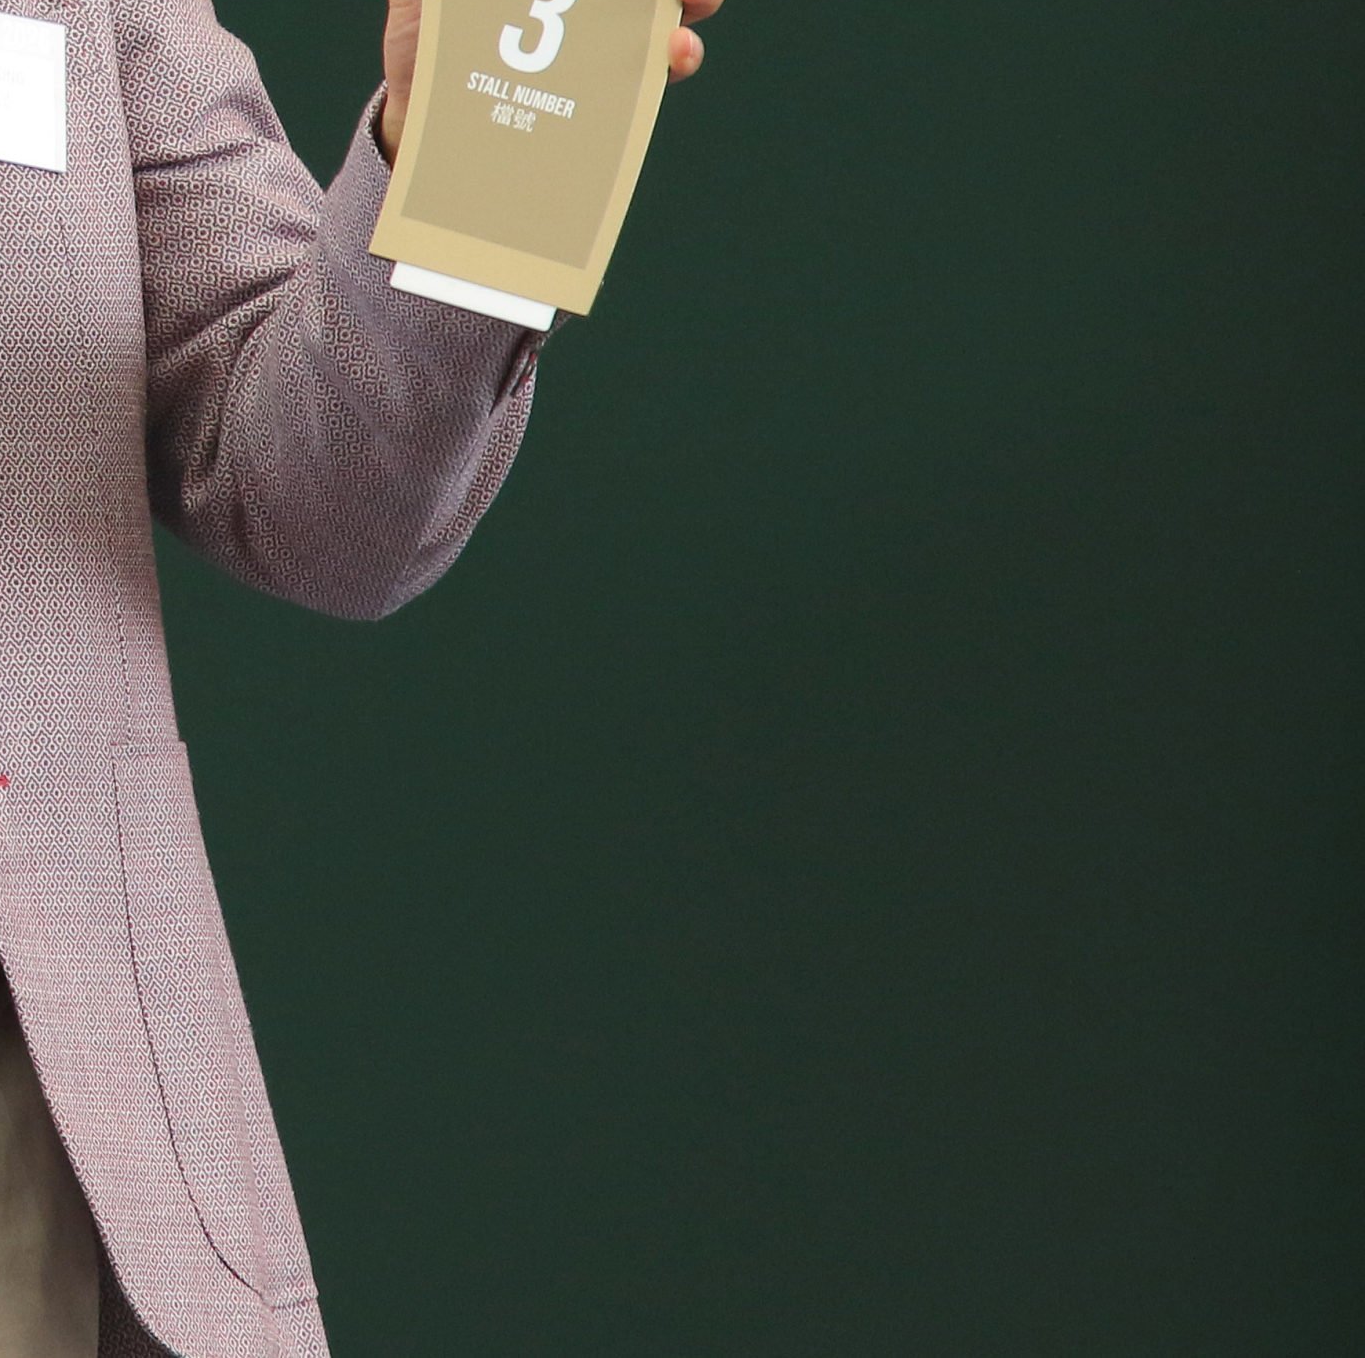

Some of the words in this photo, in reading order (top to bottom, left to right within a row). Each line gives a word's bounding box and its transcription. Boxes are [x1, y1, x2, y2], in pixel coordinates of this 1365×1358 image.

[467, 71, 510, 100] STALL
[512, 84, 576, 119] NUMBER
[490, 101, 537, 132] 檔號
